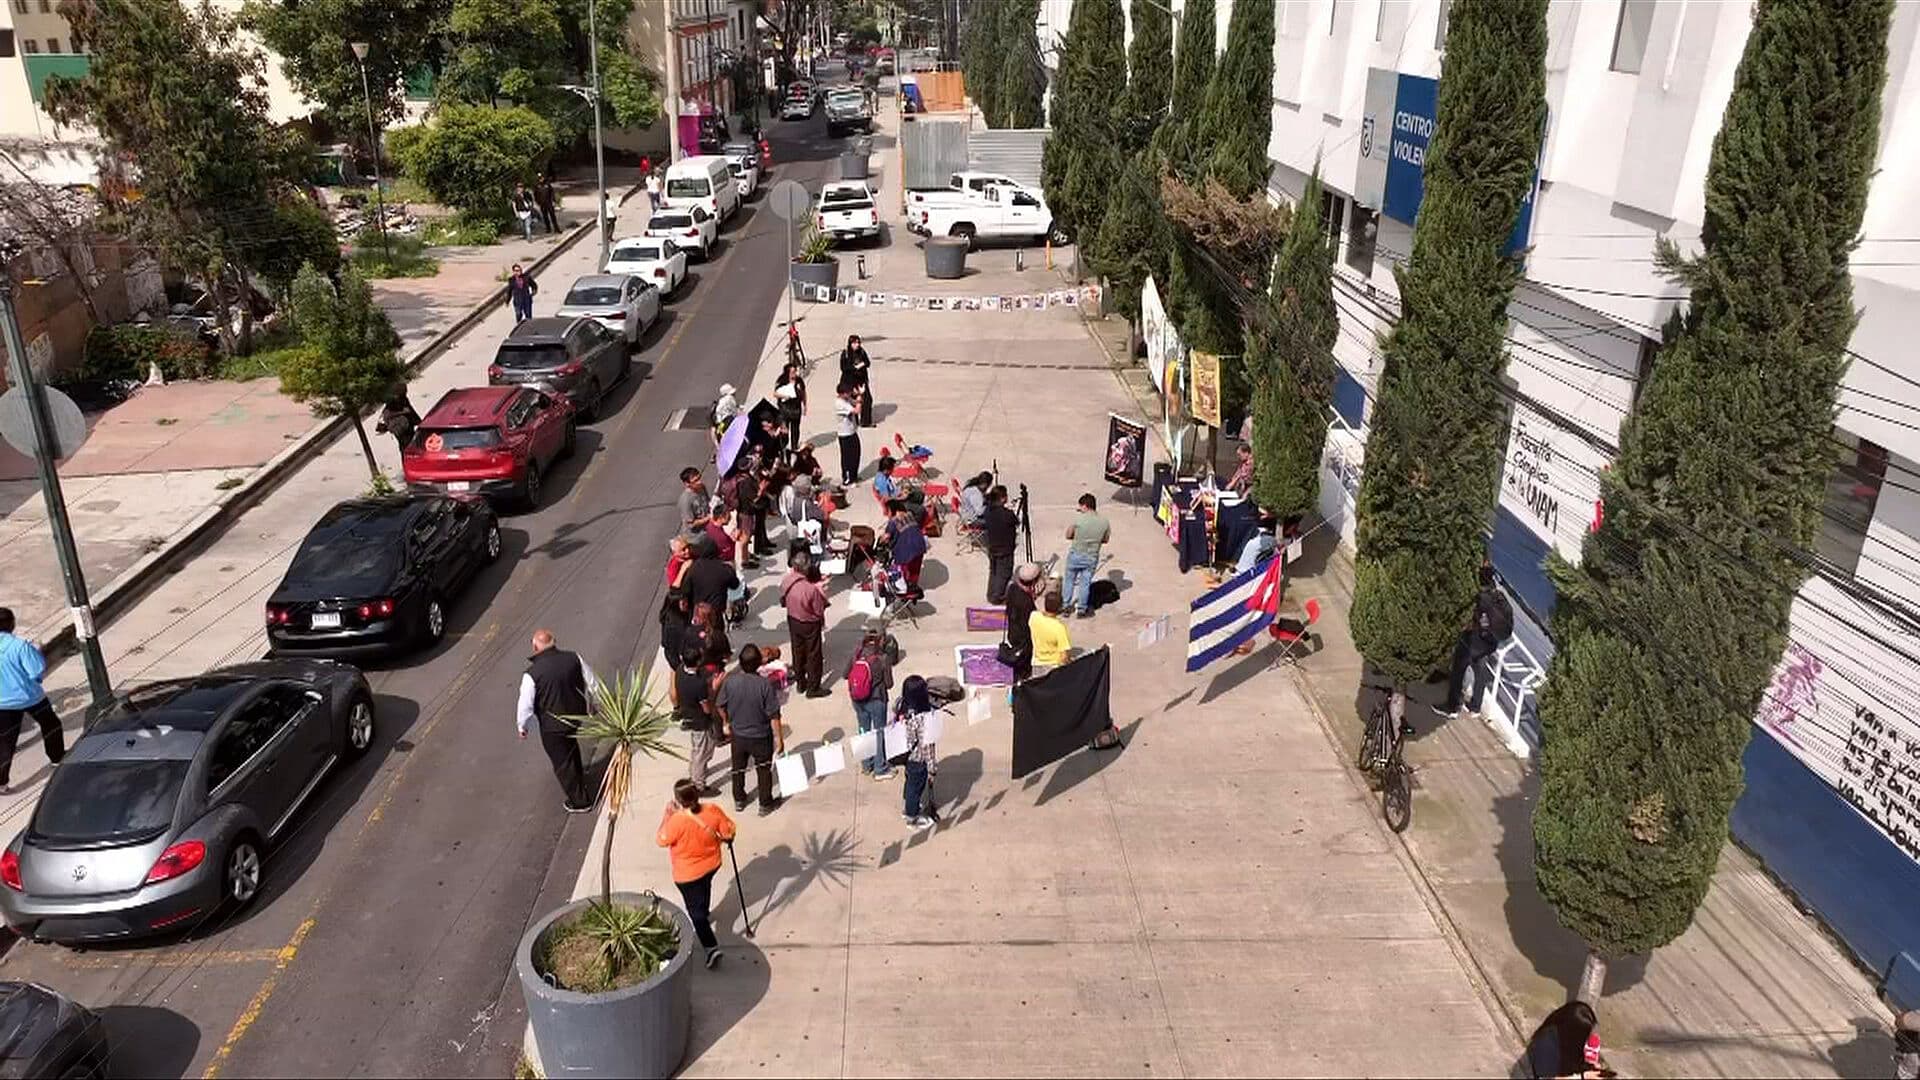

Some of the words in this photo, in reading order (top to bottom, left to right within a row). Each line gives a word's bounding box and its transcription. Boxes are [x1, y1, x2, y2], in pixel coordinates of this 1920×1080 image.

[1395, 110, 1433, 138] CENTRO
[1526, 483, 1559, 534] UNAM
[1887, 728, 1897, 744] a
[1881, 749, 1891, 762] a
